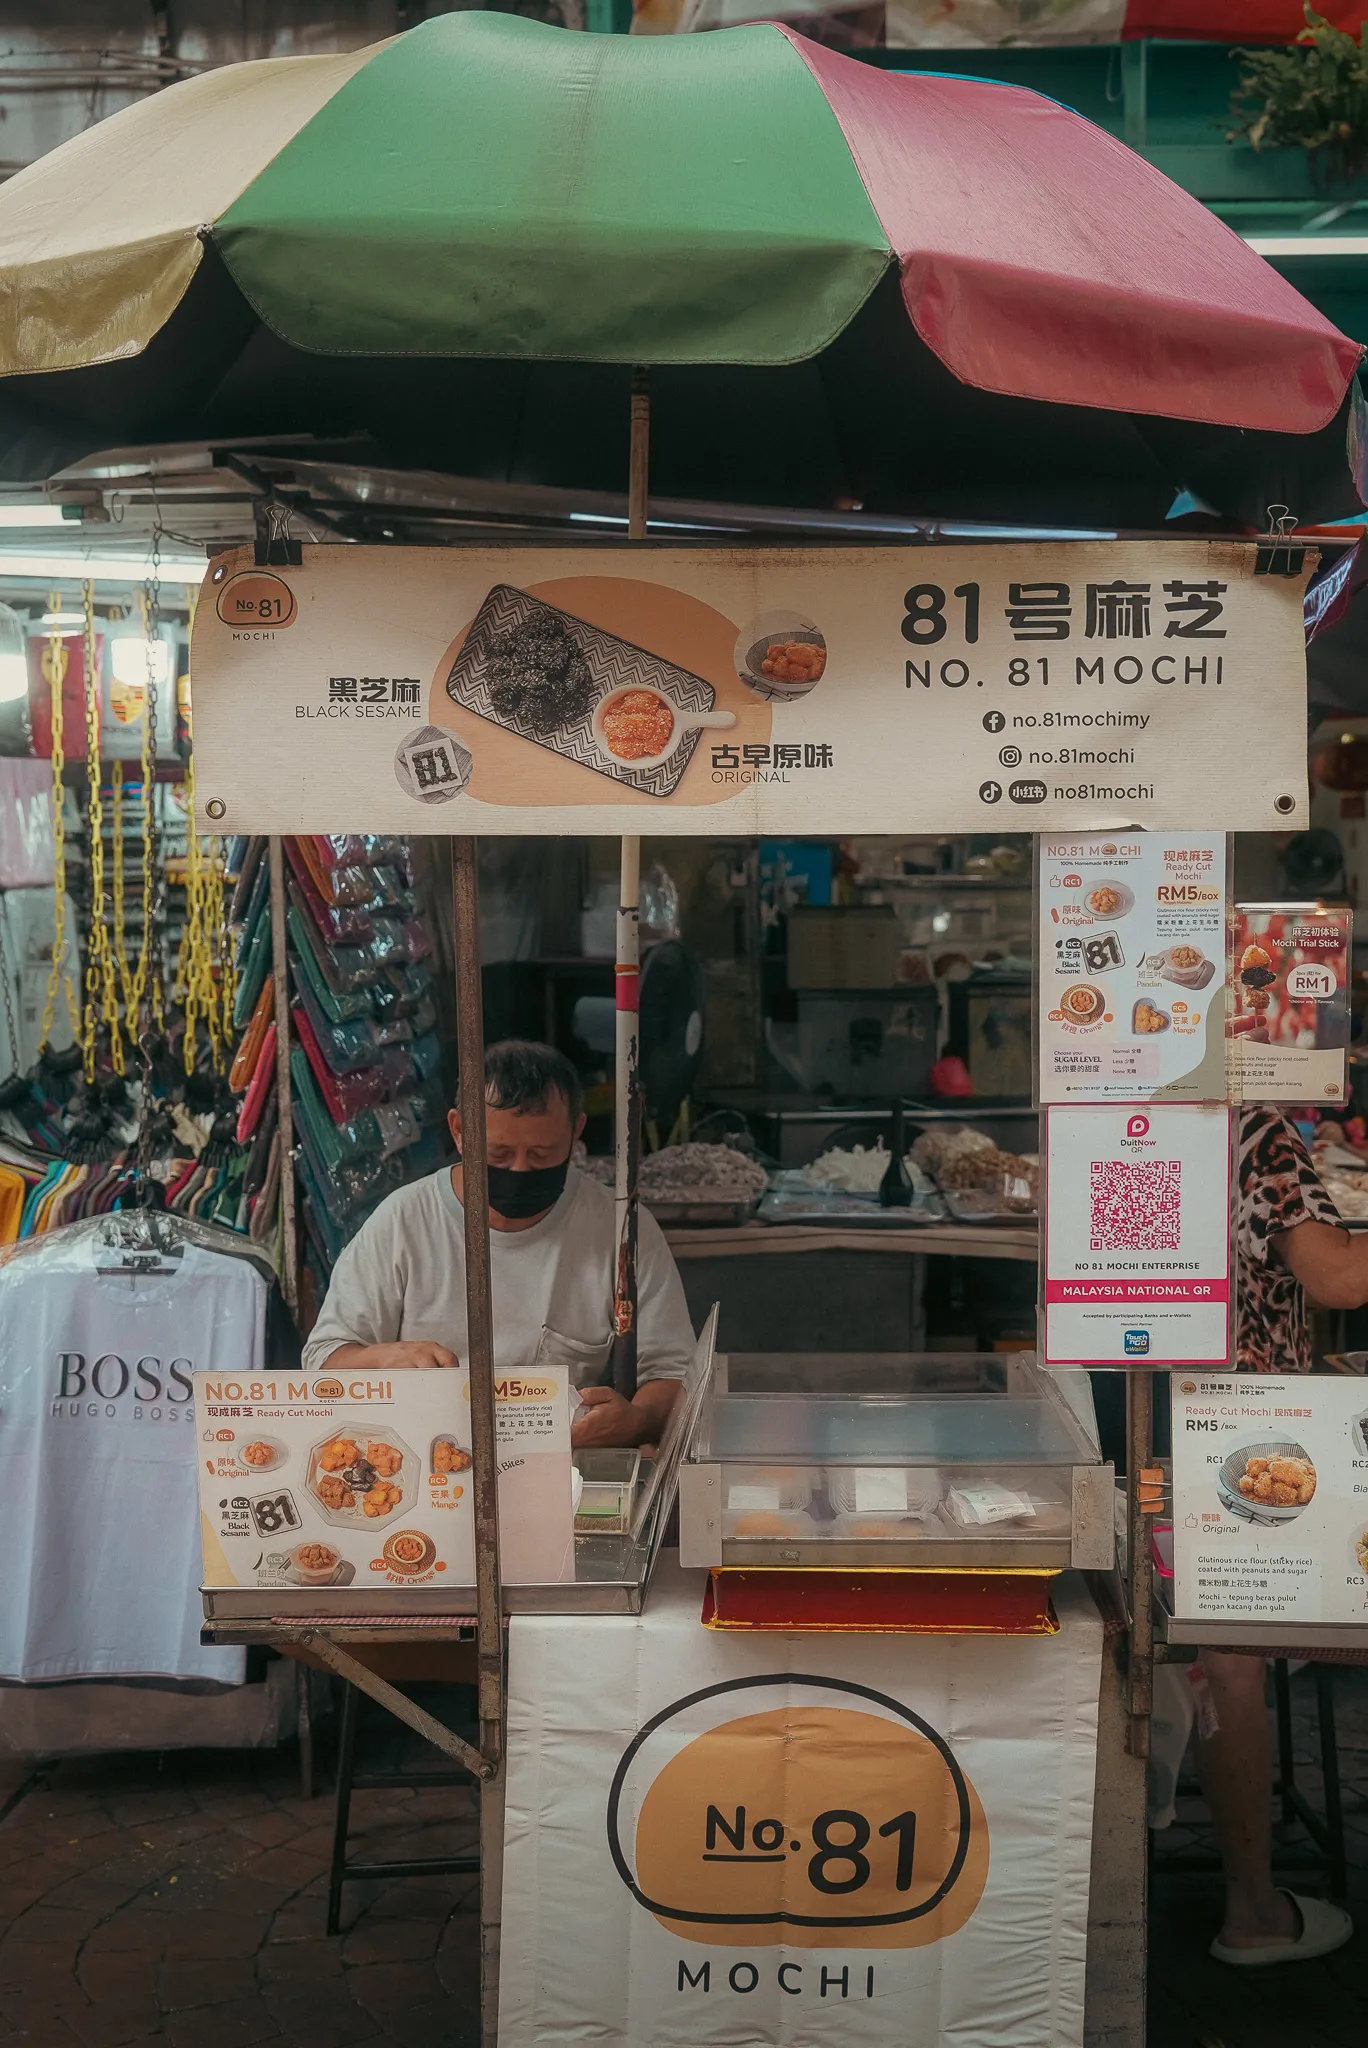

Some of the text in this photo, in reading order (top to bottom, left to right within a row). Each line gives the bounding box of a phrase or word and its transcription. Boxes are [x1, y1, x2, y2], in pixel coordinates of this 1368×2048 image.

[232, 632, 277, 641] MOCHI
[905, 655, 1224, 690] NO. 81 MOCHI
[328, 677, 421, 704] 黑芝麻
[295, 705, 422, 718] BLACK SESAME
[1012, 708, 1151, 730] no.81mochimy
[710, 743, 834, 771] 古早原味
[1029, 746, 1135, 764] no.81mochi
[711, 771, 791, 784] ORIGINAL
[1054, 783, 1154, 799] no81mochi
[1163, 850, 1213, 862] 现成麻芝
[1165, 862, 1212, 872] Ready Cut
[1175, 872, 1202, 880] Mochi
[1064, 877, 1081, 886] RC1
[1062, 905, 1081, 914] 原味
[1062, 916, 1094, 926] Original
[1292, 927, 1340, 937] 麻芝初体验
[1272, 939, 1339, 948] Mochi Trial Stick
[1172, 1017, 1189, 1025] 芒果
[1079, 1021, 1103, 1035] Orange
[1172, 1026, 1196, 1034] Mango
[1120, 1139, 1156, 1147] DuitNow
[1142, 1262, 1200, 1270] ENTERPRISE
[1063, 1286, 1211, 1296] MALAYSIA NATIONAL QR
[54, 1353, 193, 1402] BOSS
[205, 1382, 276, 1401] NO.81
[52, 1403, 194, 1422] HUGO BOSS
[207, 1407, 333, 1418] 现成麻芝 Ready Cut Mochi
[1185, 1406, 1217, 1416] Ready
[1220, 1407, 1237, 1416] Cut
[1241, 1408, 1271, 1416] Mochi
[1186, 1420, 1218, 1432] RM5
[217, 1457, 236, 1466] 原味
[501, 1458, 525, 1471] Bites
[1206, 1456, 1223, 1464] RC1
[217, 1469, 249, 1478] Original
[431, 1489, 449, 1499] 芒果
[431, 1501, 458, 1509] Mango
[1201, 1514, 1220, 1522] 原味
[228, 1522, 250, 1530] Black
[1202, 1524, 1240, 1534] Original
[1197, 1556, 1232, 1564] Glutinous
[1249, 1557, 1267, 1565] flour
[1269, 1558, 1294, 1567] (sticky
[1295, 1558, 1313, 1566] rice)
[1241, 1567, 1270, 1575] peanuts
[1287, 1568, 1307, 1576] sugar
[407, 1570, 436, 1585] Orange
[1346, 1577, 1365, 1585] RC3
[1228, 1594, 1253, 1602] tepung
[1277, 1595, 1296, 1603] pulut
[1199, 1603, 1225, 1611] dengan
[1227, 1604, 1252, 1612] kacang
[1269, 1604, 1285, 1612] gula
[677, 1960, 874, 1998] MOCHI
